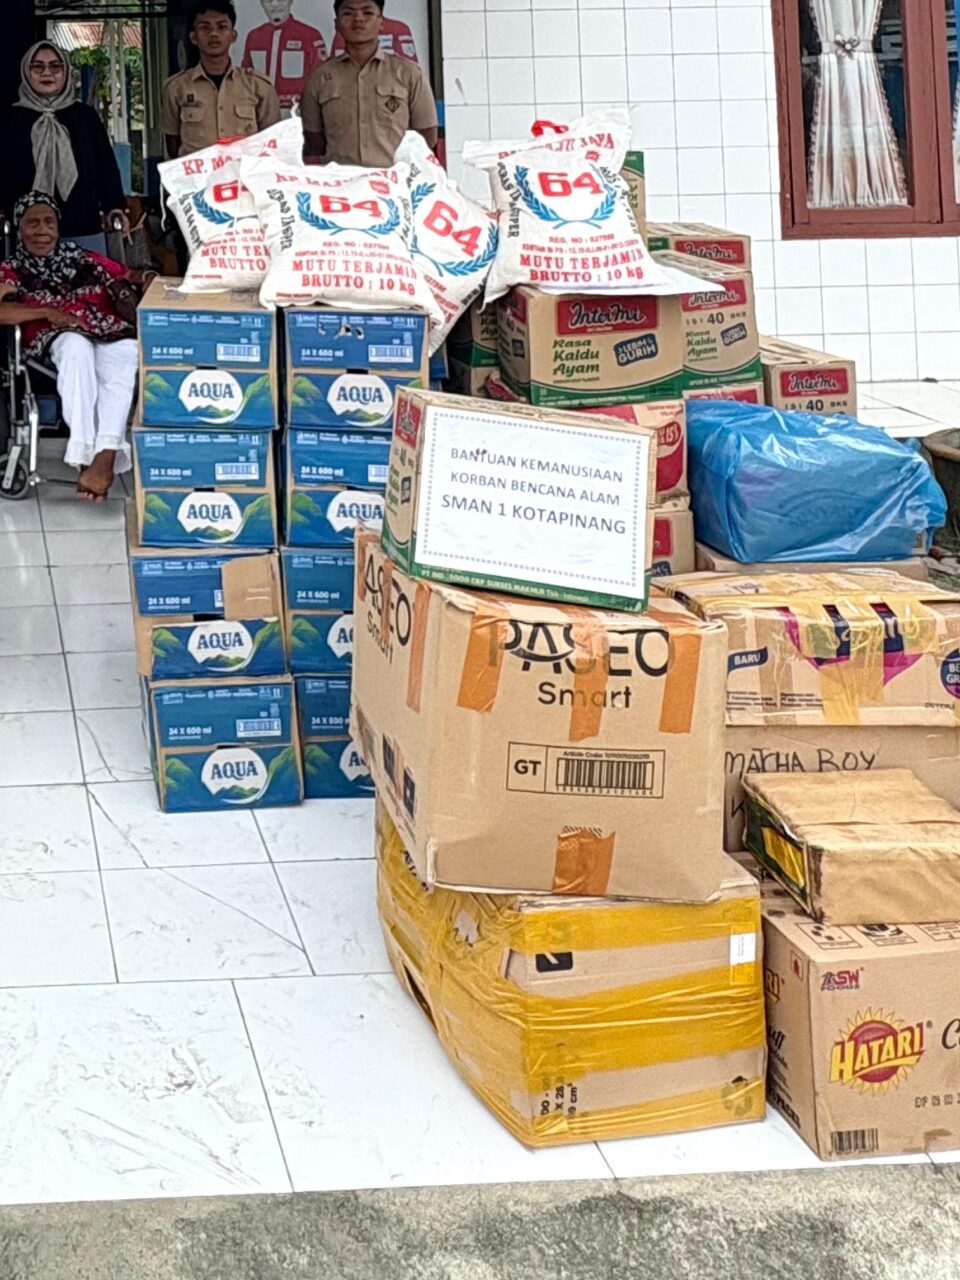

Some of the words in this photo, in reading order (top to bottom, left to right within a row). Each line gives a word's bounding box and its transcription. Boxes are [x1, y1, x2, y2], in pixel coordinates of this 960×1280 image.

[538, 172, 604, 197] 64
[319, 194, 384, 220] 64
[423, 200, 483, 257] 64
[520, 254, 564, 269] MUTU
[530, 269, 592, 282] BRUTTO
[607, 268, 622, 281] 10
[553, 349, 600, 362] Kaldu
[618, 345, 656, 364] GURIH
[553, 363, 600, 376] Ayam
[188, 382, 234, 401] AQUA
[336, 386, 384, 404] AQUA
[806, 399, 824, 412] 40
[451, 447, 517, 467] BANTUAN
[520, 458, 623, 483] KEMANUSIAAN
[451, 471, 506, 490] KORBAN
[511, 480, 576, 500] BENCANA
[579, 489, 621, 506] ALAM
[186, 503, 233, 522] AQUA
[441, 494, 492, 514] SMAN
[498, 503, 506, 517] 1
[512, 504, 626, 535] KOTAPINANG
[196, 631, 244, 651] AQUA
[733, 653, 761, 666] BARU
[538, 682, 632, 709] Smart
[209, 760, 259, 781] AQUA
[514, 759, 541, 776] GT
[829, 1021, 925, 1083] HATARI
